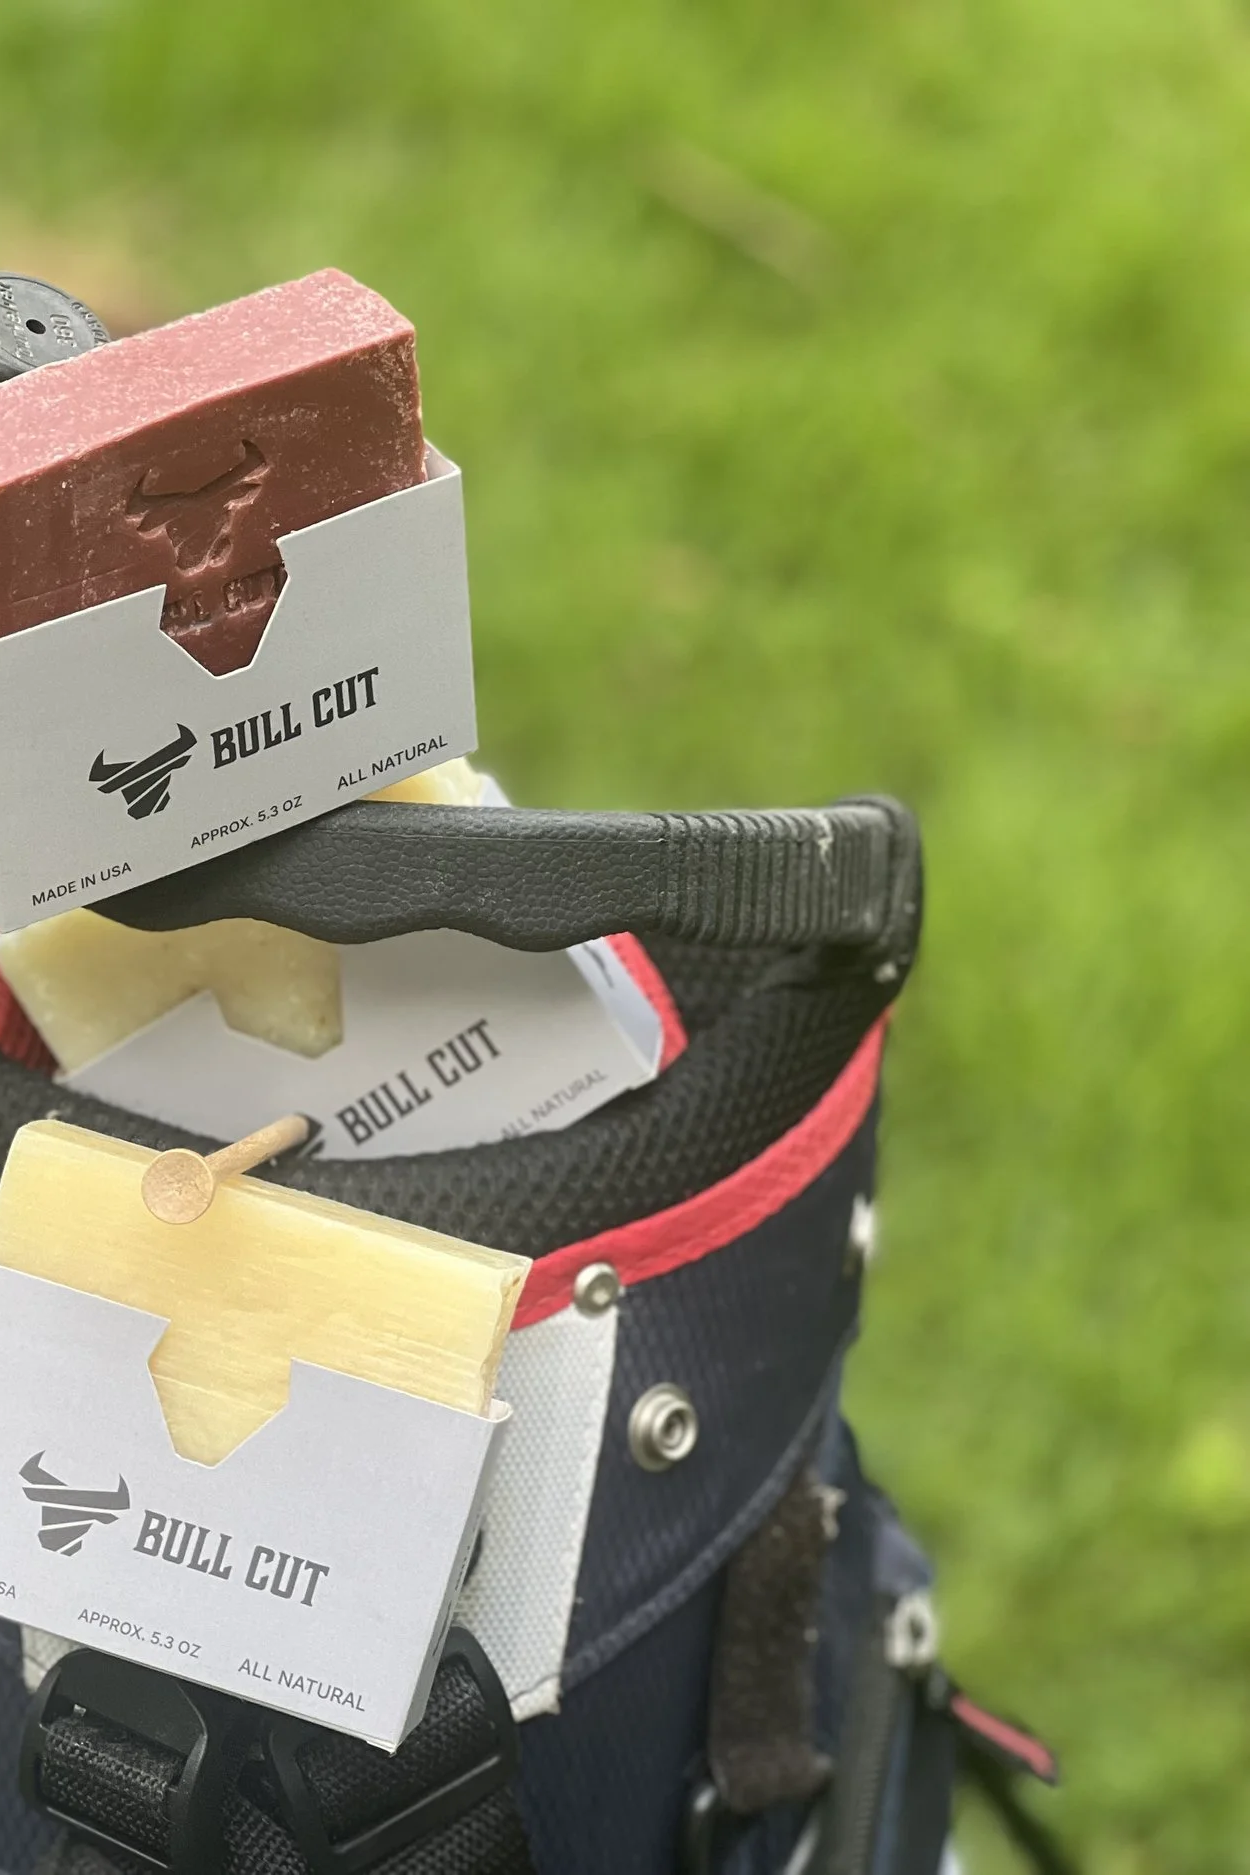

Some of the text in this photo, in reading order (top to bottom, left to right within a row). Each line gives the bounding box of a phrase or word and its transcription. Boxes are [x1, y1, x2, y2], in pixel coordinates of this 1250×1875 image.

[211, 667, 378, 769] BULL CUT
[338, 736, 447, 790] ALL NATURAL
[191, 795, 302, 848] APPROX. 5.3 OZ
[33, 863, 131, 906] MADE IN USA
[336, 1018, 501, 1146] BULL CUT
[530, 1068, 608, 1121] NATURAL
[134, 1510, 329, 1606] BULL CUT
[78, 1609, 201, 1658] APPROX. 5.3 OZ
[238, 1659, 364, 1711] ALL NATURAL
